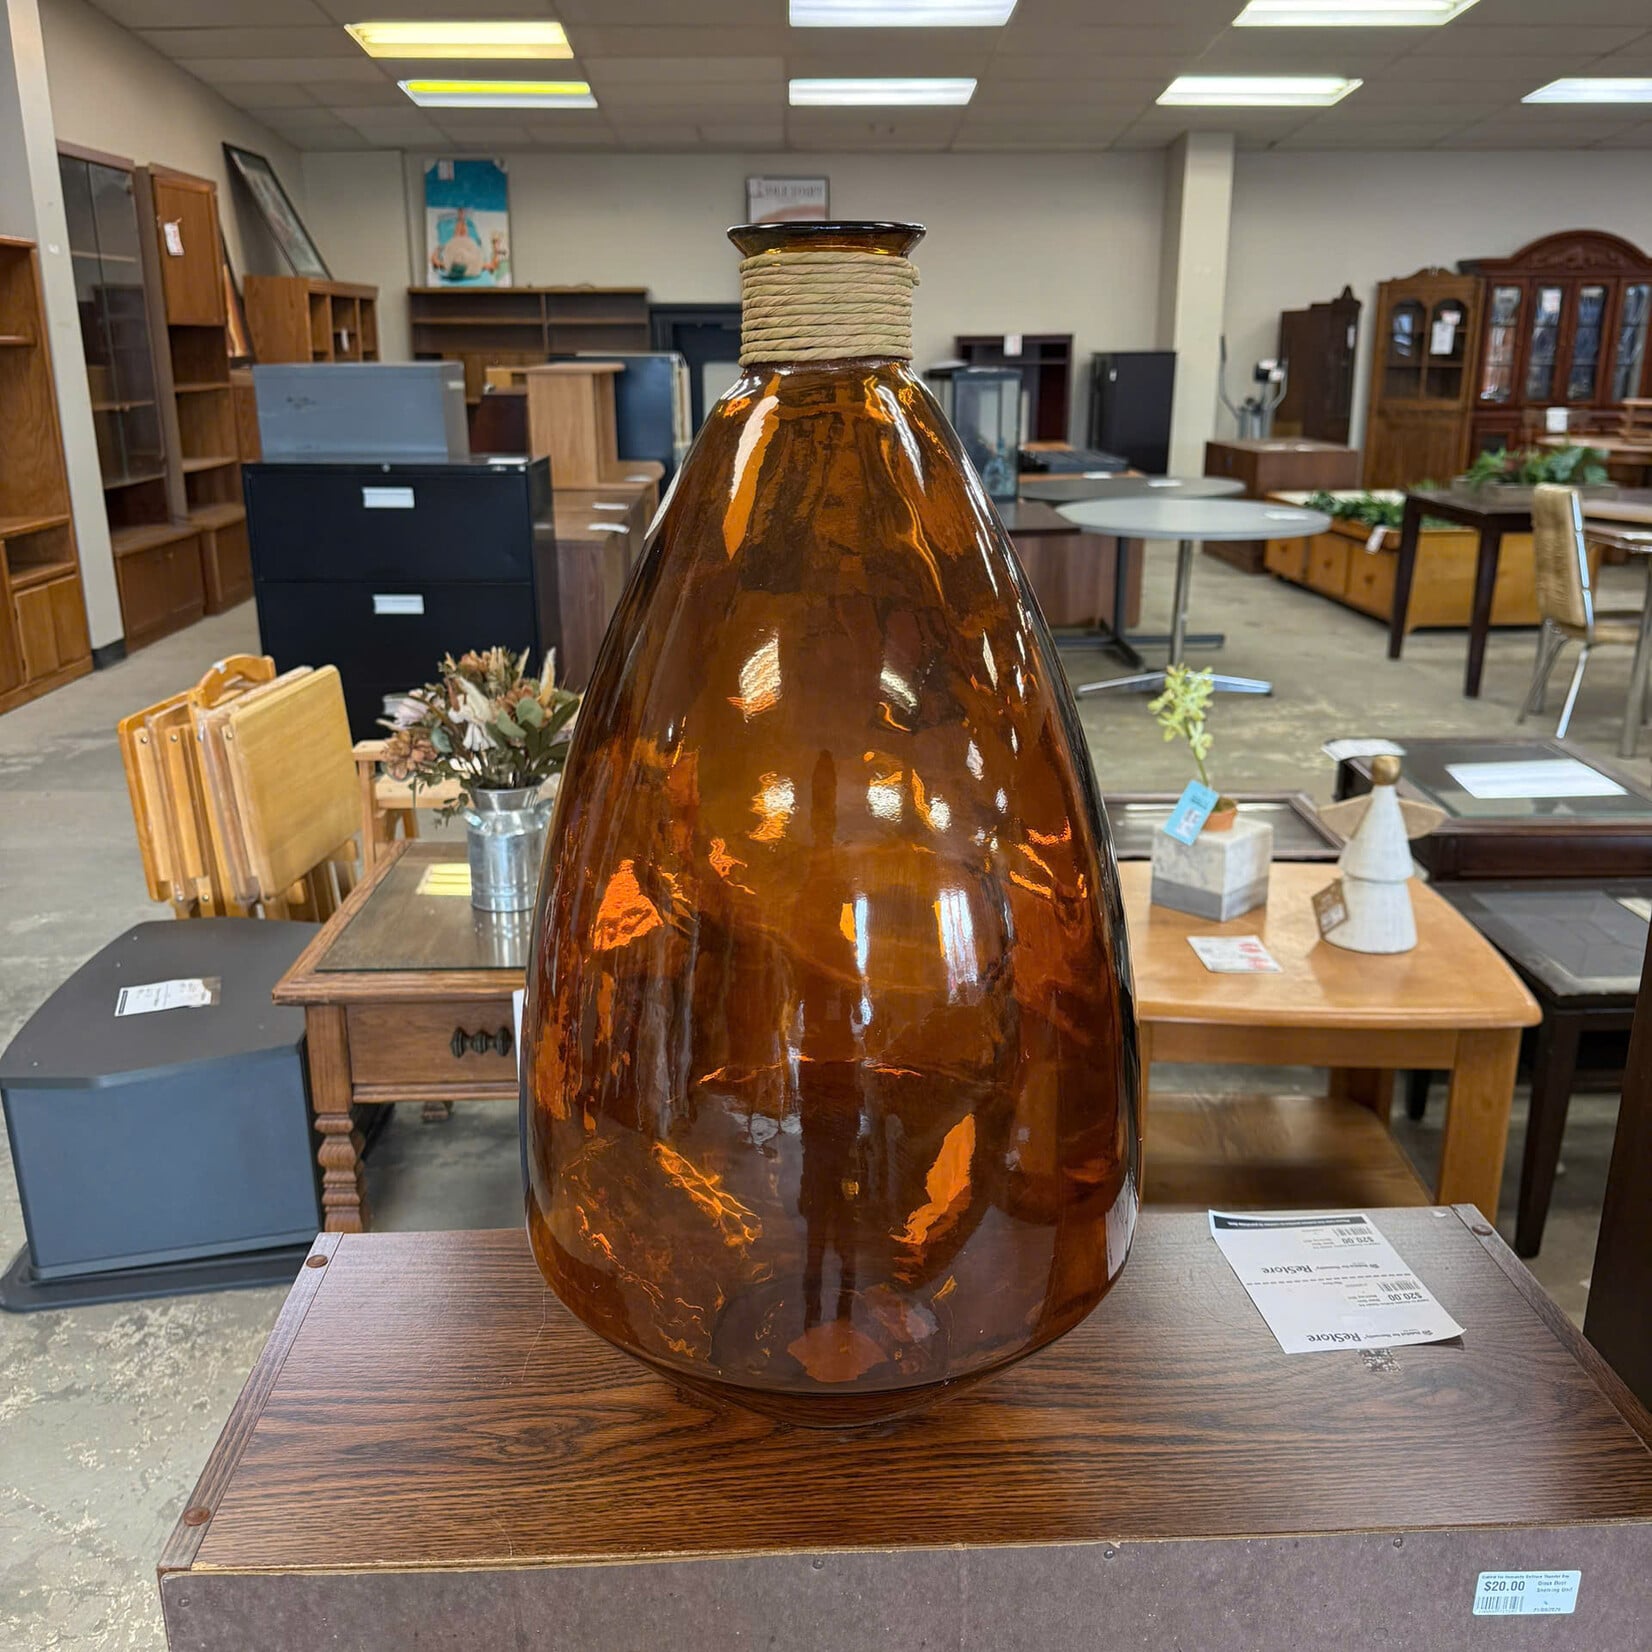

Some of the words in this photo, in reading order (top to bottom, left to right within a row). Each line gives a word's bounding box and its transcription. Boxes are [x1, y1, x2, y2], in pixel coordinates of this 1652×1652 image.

[1262, 1264, 1313, 1275] ReStore
[1388, 1291, 1423, 1302] $20.00
[1307, 1332, 1362, 1343] ReStore
[1484, 1580, 1525, 1592] $20.00
